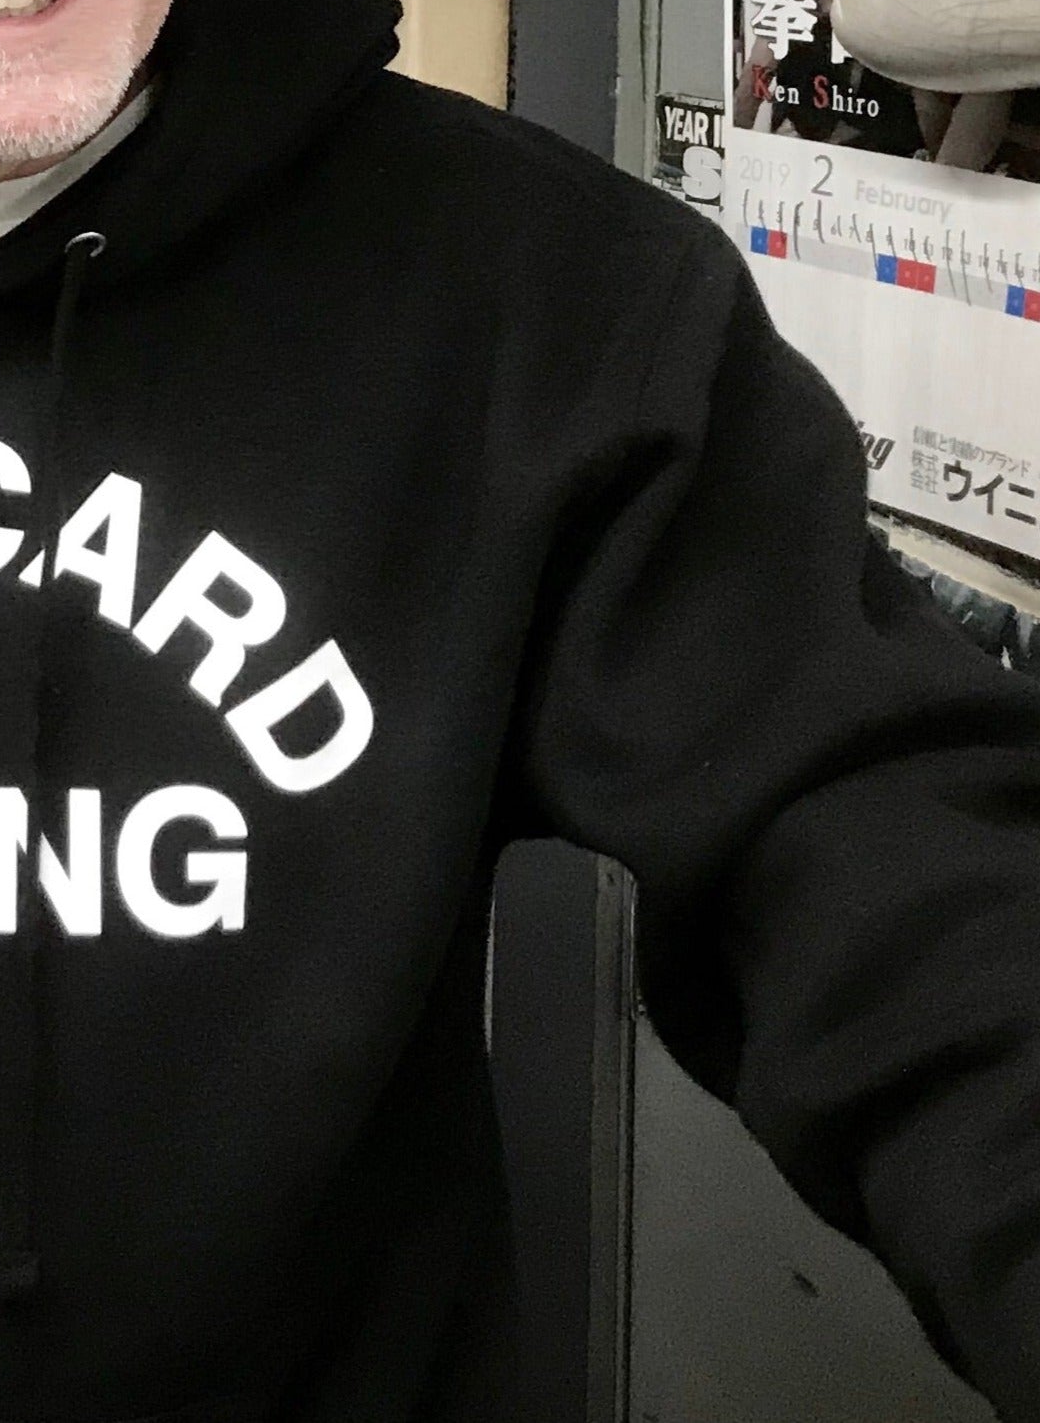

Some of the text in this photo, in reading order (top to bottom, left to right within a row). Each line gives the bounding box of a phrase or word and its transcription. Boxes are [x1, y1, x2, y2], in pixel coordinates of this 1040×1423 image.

[751, 64, 880, 118] Ken Shiro
[664, 105, 709, 146] YEAR
[739, 154, 954, 224] 2019 2 February
